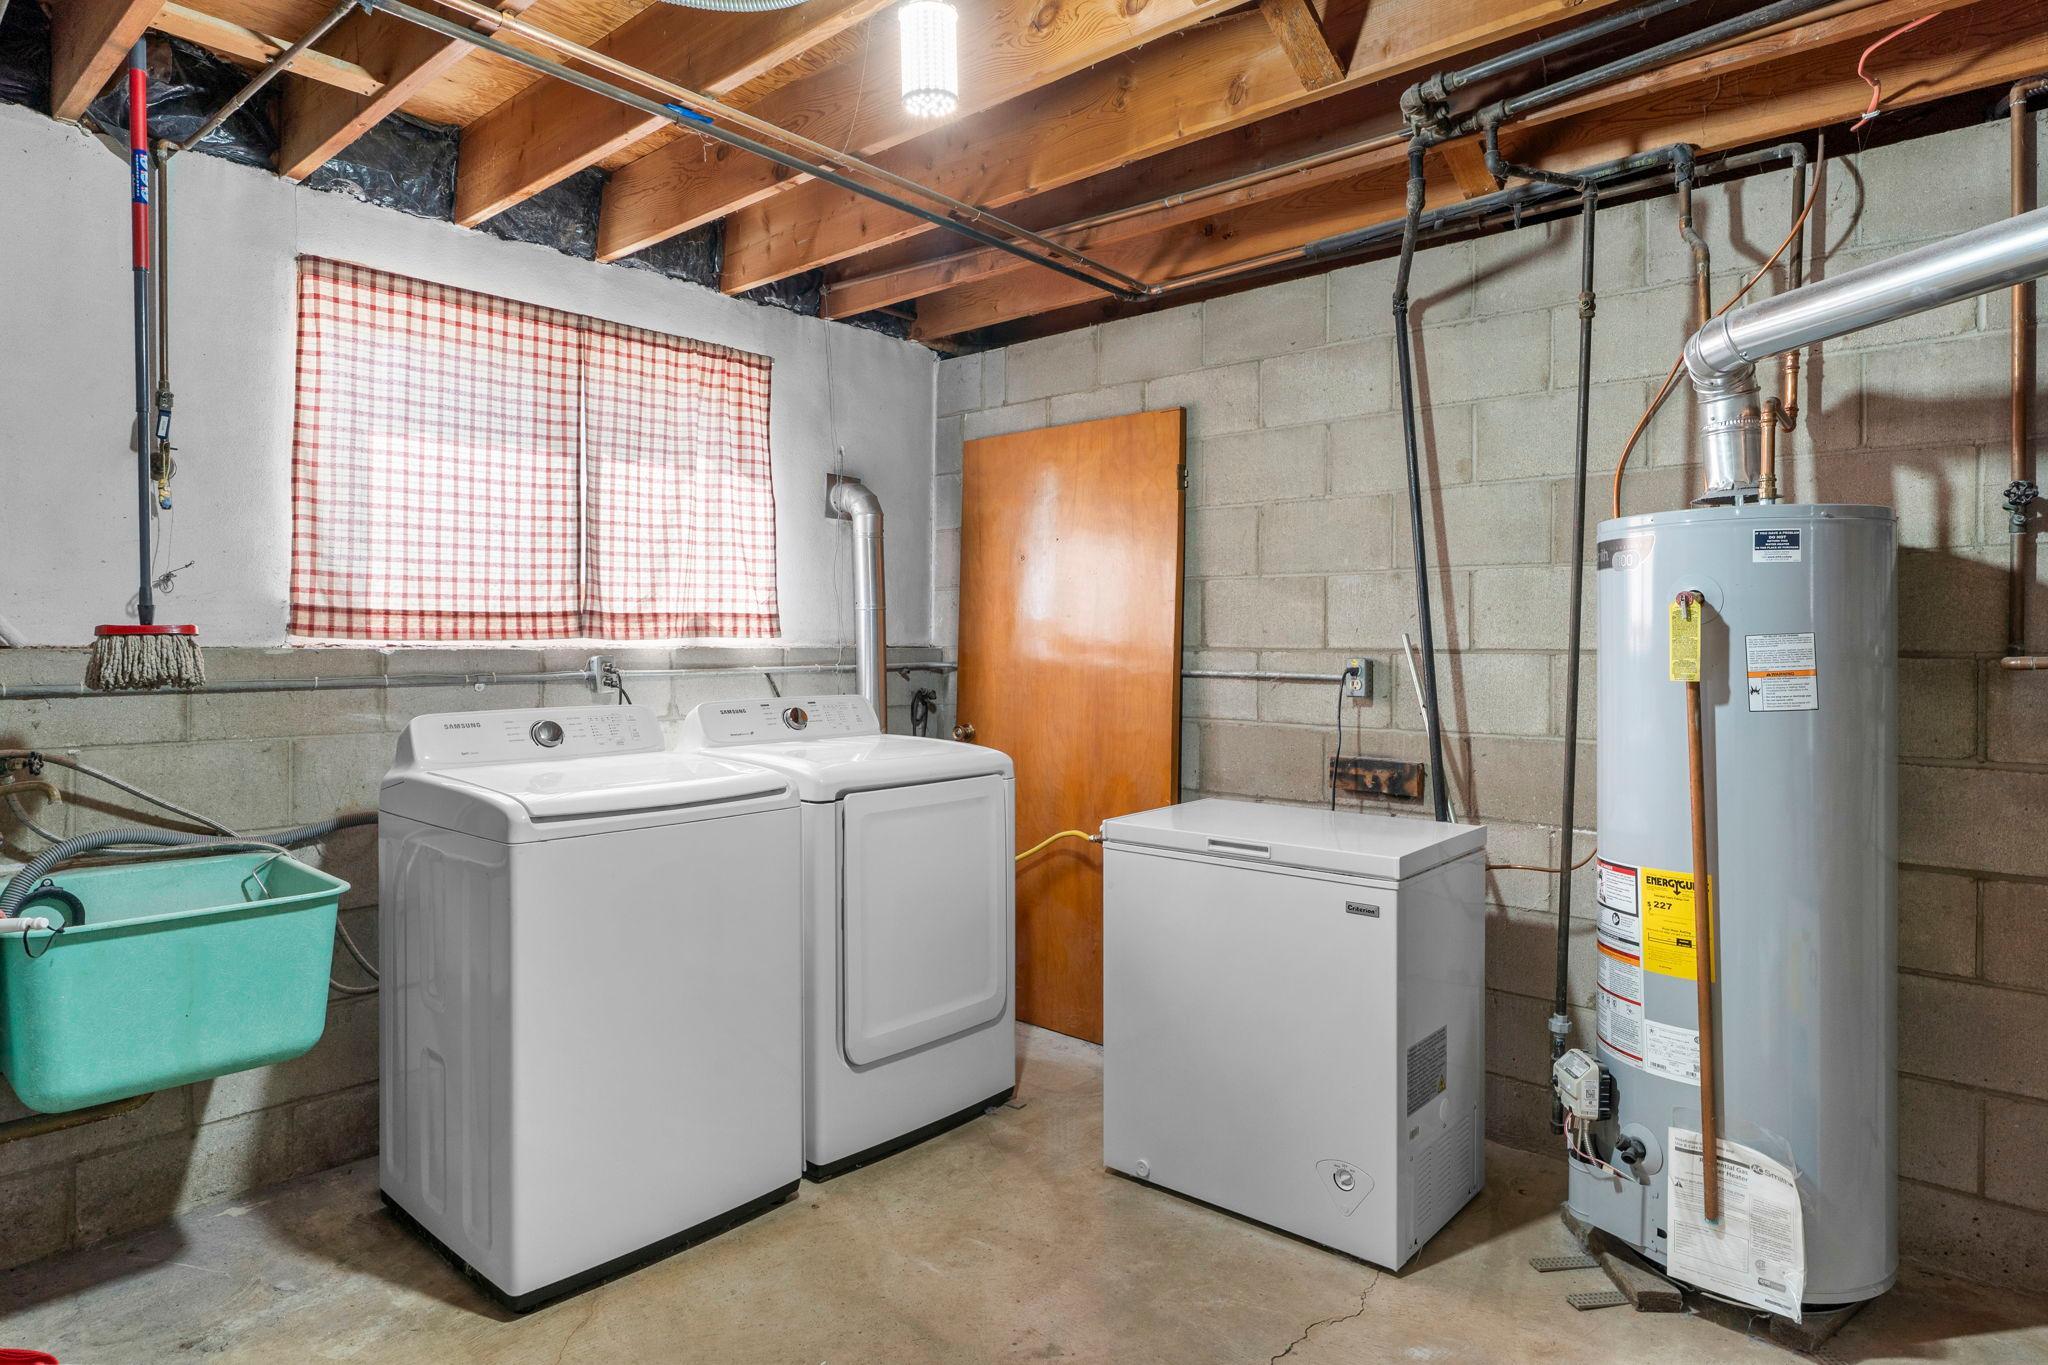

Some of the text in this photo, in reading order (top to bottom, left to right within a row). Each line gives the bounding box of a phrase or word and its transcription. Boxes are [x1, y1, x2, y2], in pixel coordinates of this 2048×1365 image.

[1348, 904, 1375, 914] Criterion
[1653, 900, 1672, 910] 227
[1726, 1170, 1748, 1182] Heater
[1736, 1167, 1748, 1176] Gas
